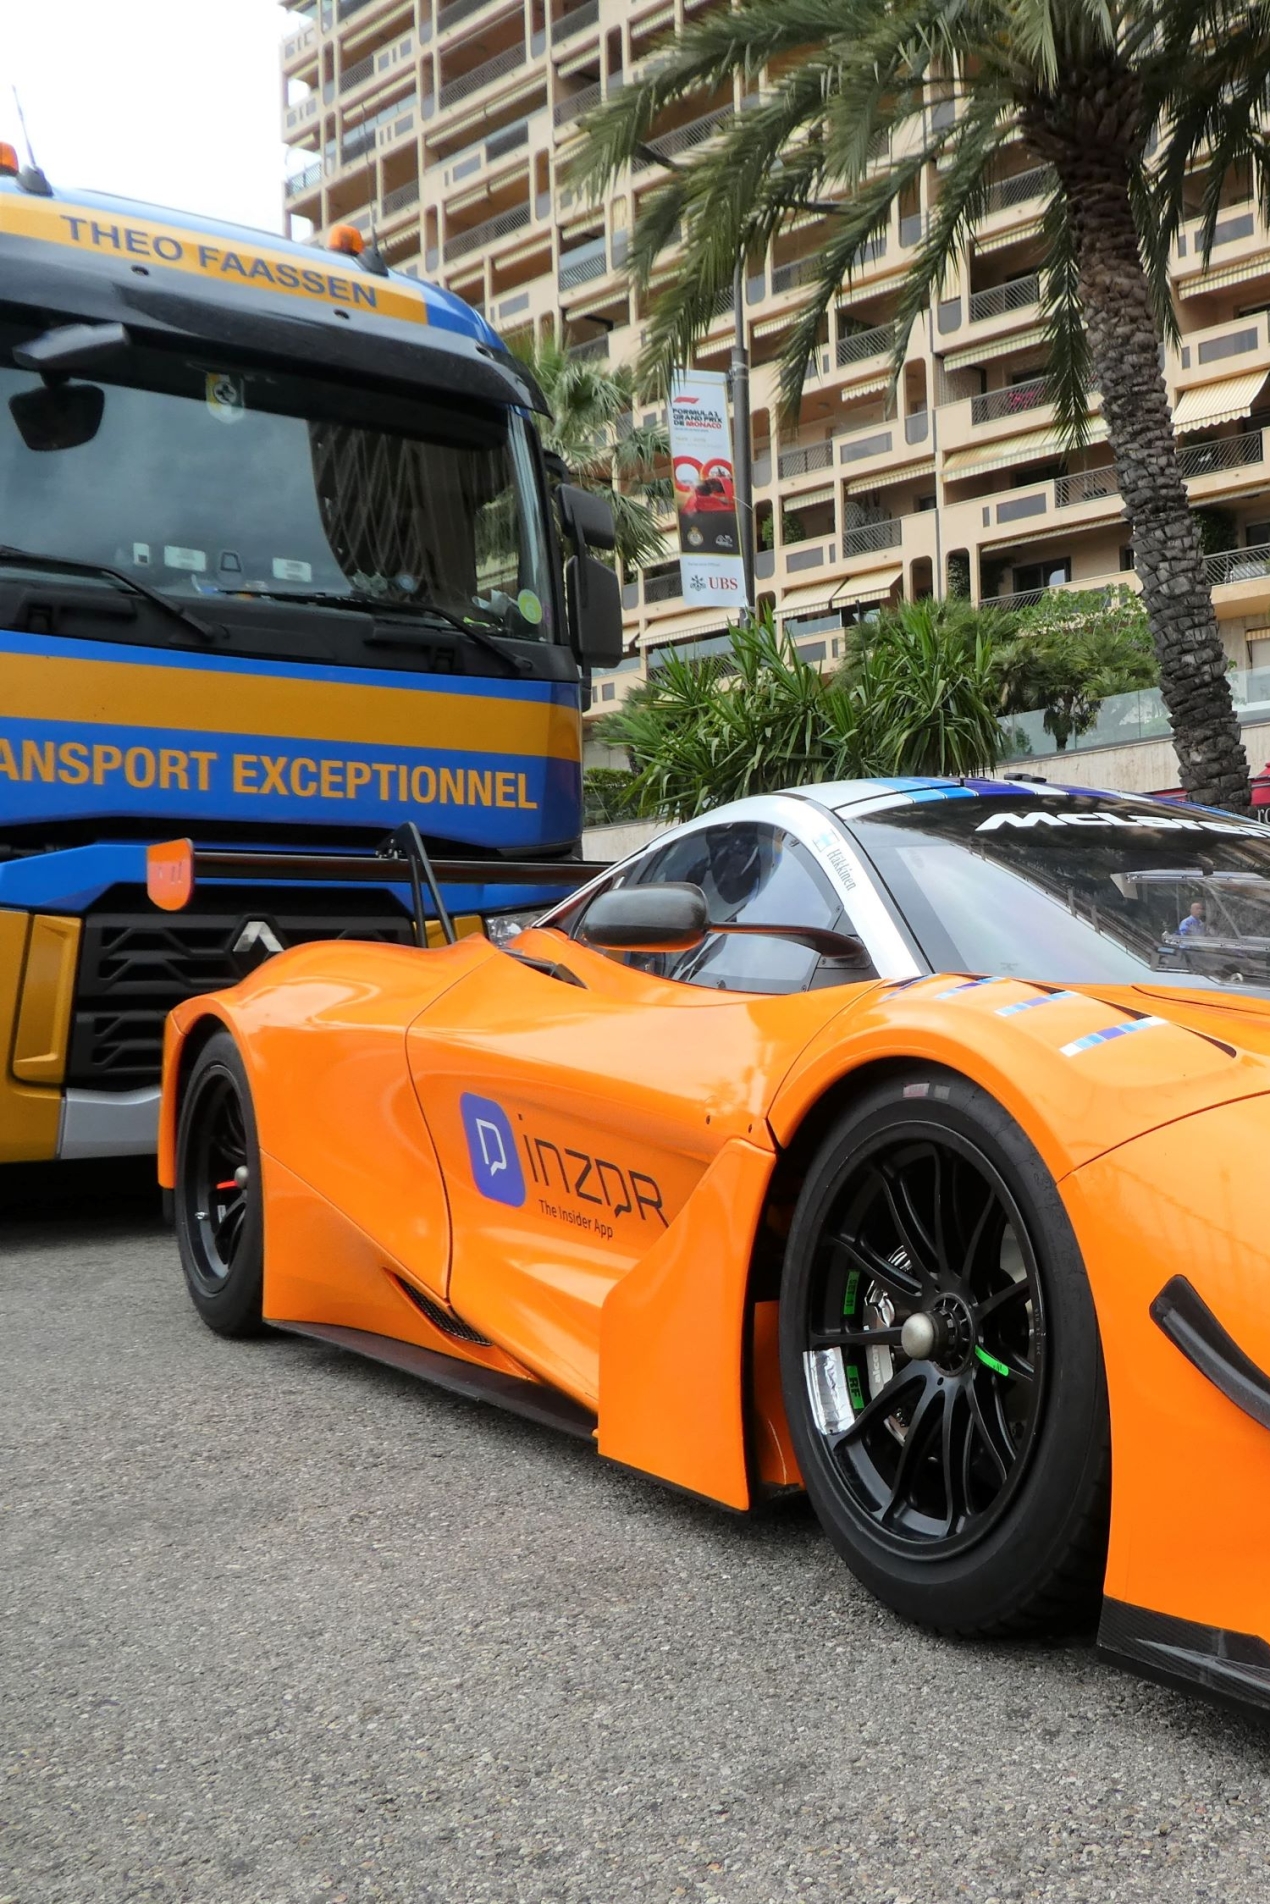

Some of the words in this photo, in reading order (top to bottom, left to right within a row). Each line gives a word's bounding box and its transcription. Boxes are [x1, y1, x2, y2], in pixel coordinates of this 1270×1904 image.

[61, 214, 184, 261] THEO
[198, 245, 378, 308] FAASSEN
[672, 408, 714, 417] FORMULA
[673, 413, 703, 421] GRAND
[685, 420, 722, 430] MONACO
[708, 576, 739, 591] UBS
[232, 753, 538, 810] EXCEPTIONNEL
[827, 848, 857, 891] Häkkinen
[538, 1199, 558, 1219] The
[559, 1206, 592, 1230] Insider
[594, 1216, 614, 1241] App
[849, 1377, 861, 1398] RF
